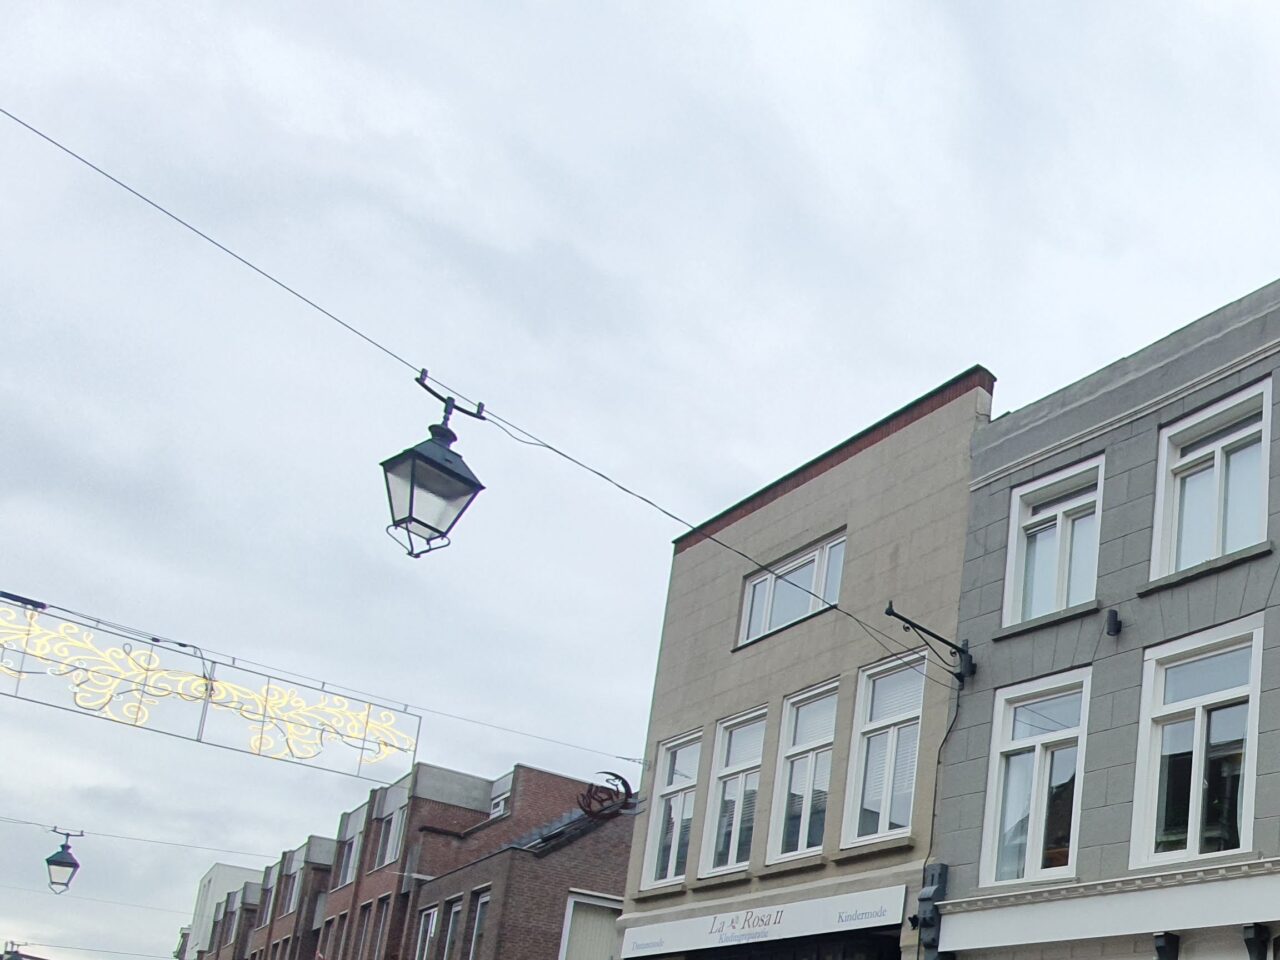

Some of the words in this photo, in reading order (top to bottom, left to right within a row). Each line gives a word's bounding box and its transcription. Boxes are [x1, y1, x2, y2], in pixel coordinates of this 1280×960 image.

[708, 915, 726, 935] La
[740, 910, 772, 930] Rosa
[837, 905, 888, 923] Kindermode
